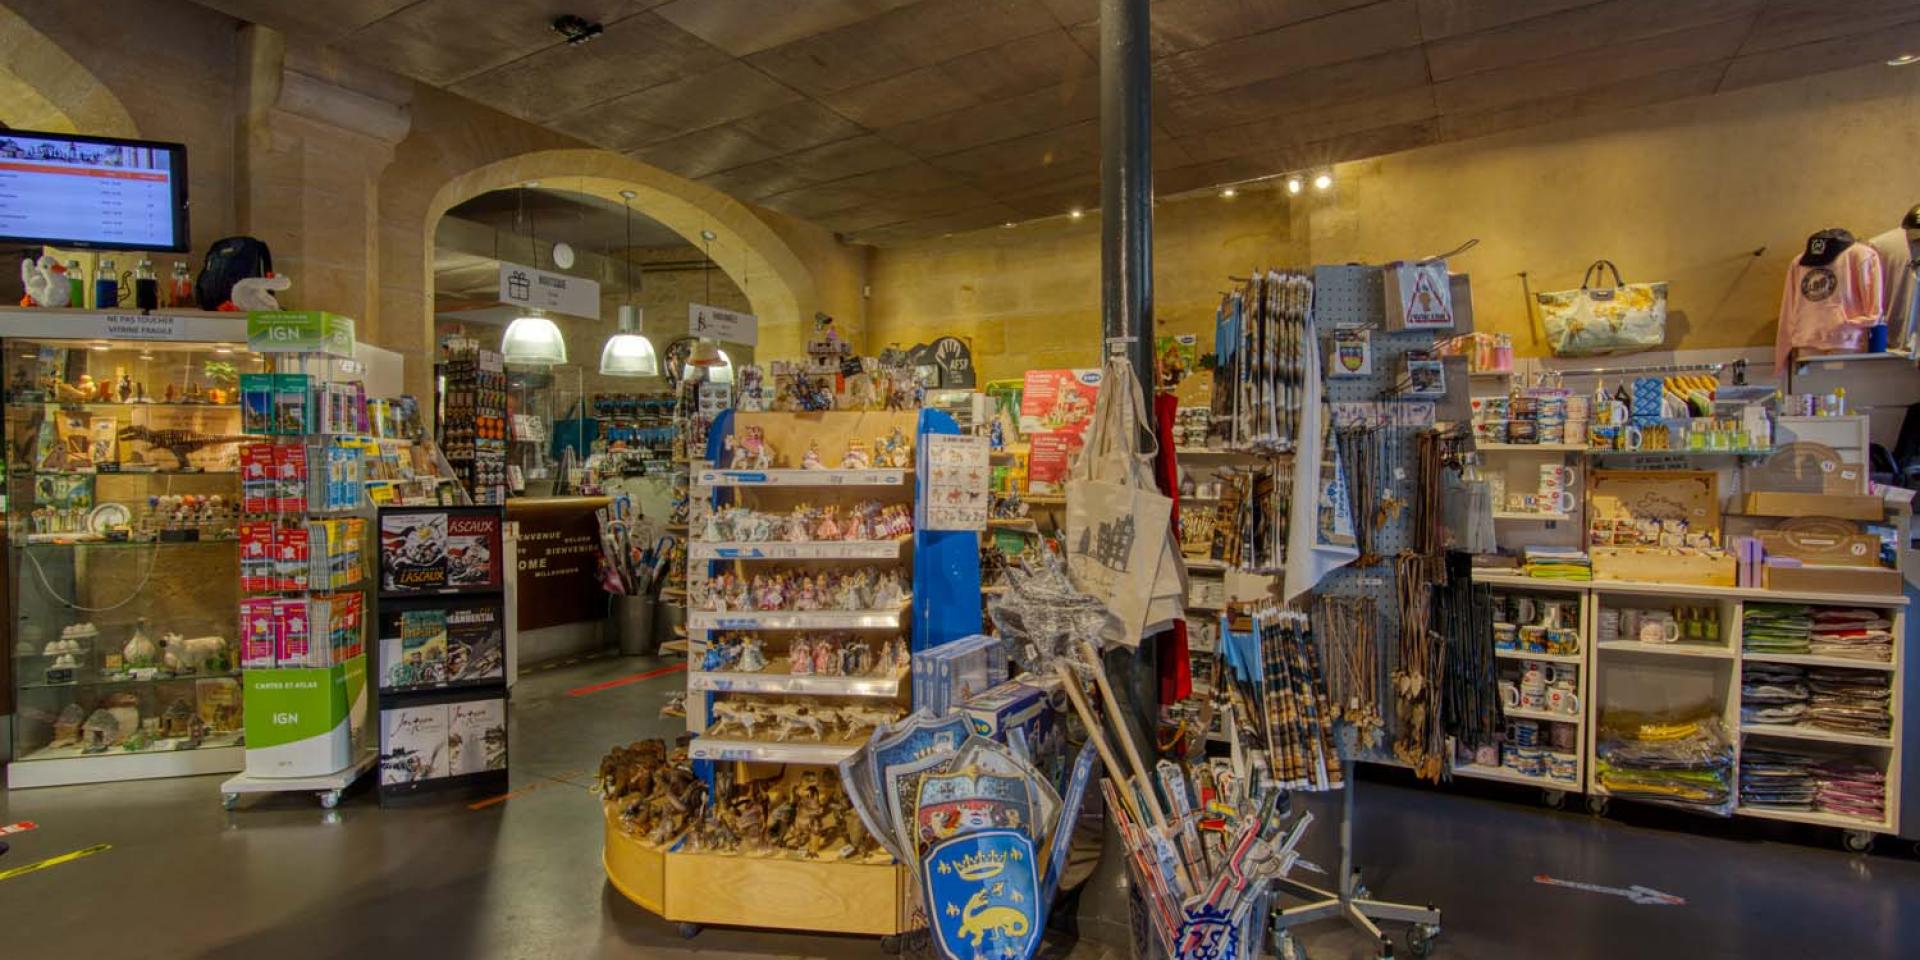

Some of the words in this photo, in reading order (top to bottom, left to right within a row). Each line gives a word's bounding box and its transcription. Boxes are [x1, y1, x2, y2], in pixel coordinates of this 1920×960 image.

[119, 315, 136, 323] PAS
[137, 316, 173, 325] TOUCHER
[108, 325, 141, 333] VITRINE
[142, 326, 174, 335] FRAGILE
[269, 325, 300, 340] IGN
[400, 571, 445, 583] LASCAUX
[255, 682, 284, 690] CARTES
[294, 681, 317, 689] ATLAS
[272, 712, 299, 725] IGN
